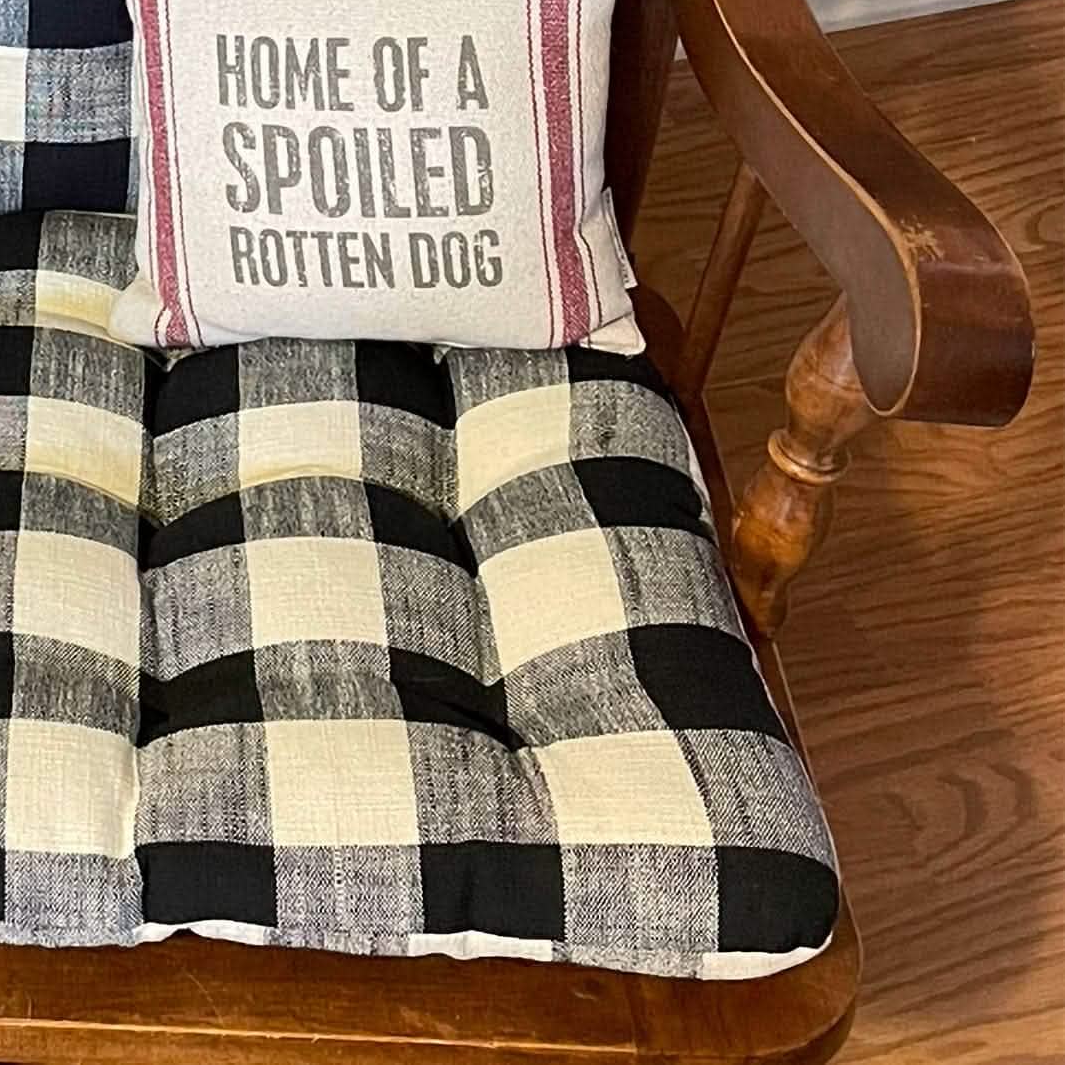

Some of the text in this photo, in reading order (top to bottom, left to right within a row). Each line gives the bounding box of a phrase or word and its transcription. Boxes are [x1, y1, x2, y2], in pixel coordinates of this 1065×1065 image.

[216, 34, 489, 112] HOME OF A
[223, 121, 495, 218] SPOILED
[230, 226, 503, 288] ROTTEN DOG
